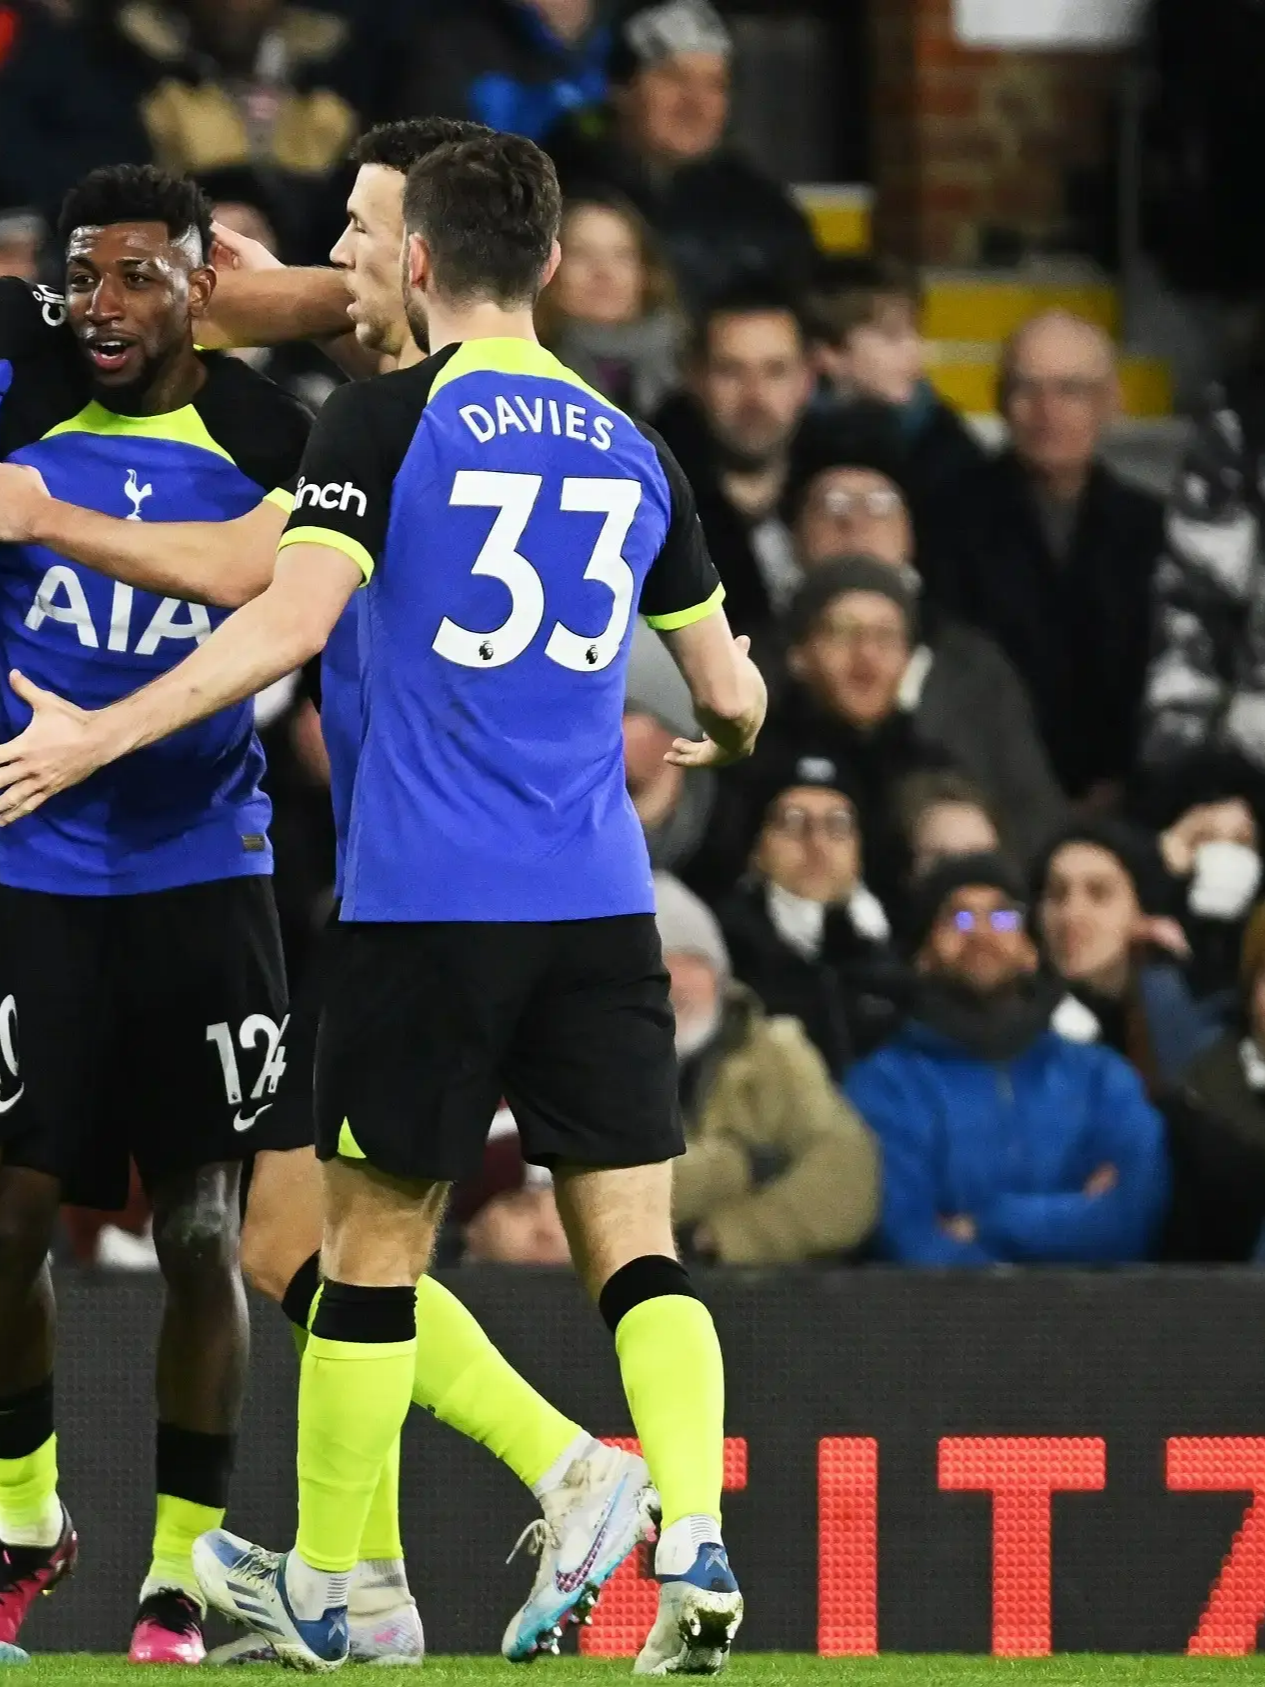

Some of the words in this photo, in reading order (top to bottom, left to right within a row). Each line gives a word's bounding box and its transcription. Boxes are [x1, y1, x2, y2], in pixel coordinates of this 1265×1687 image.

[458, 395, 615, 450] DAVIES
[24, 565, 213, 656] AIA
[431, 469, 642, 673] 33
